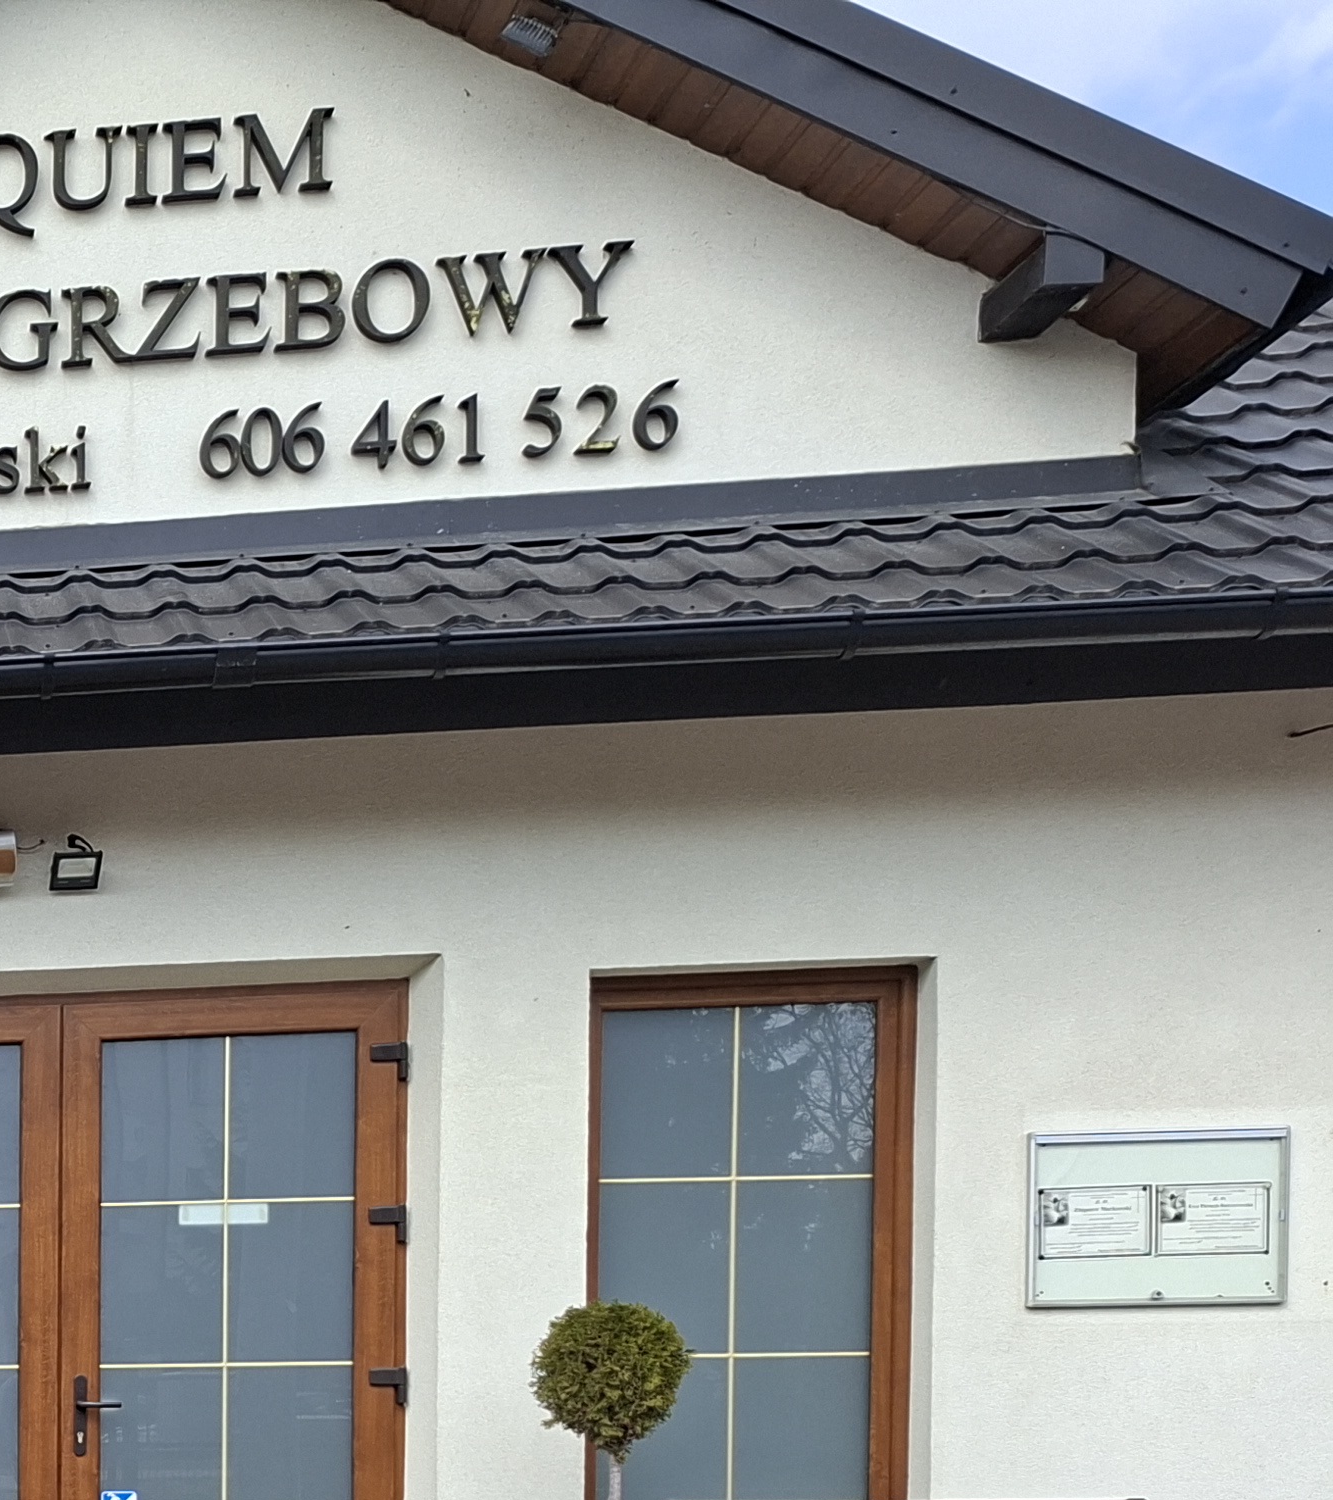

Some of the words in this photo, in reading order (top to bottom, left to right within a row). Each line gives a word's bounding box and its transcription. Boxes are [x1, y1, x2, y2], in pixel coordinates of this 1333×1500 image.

[199, 401, 326, 480] 606
[351, 392, 485, 470] 461
[520, 378, 681, 460] 526
